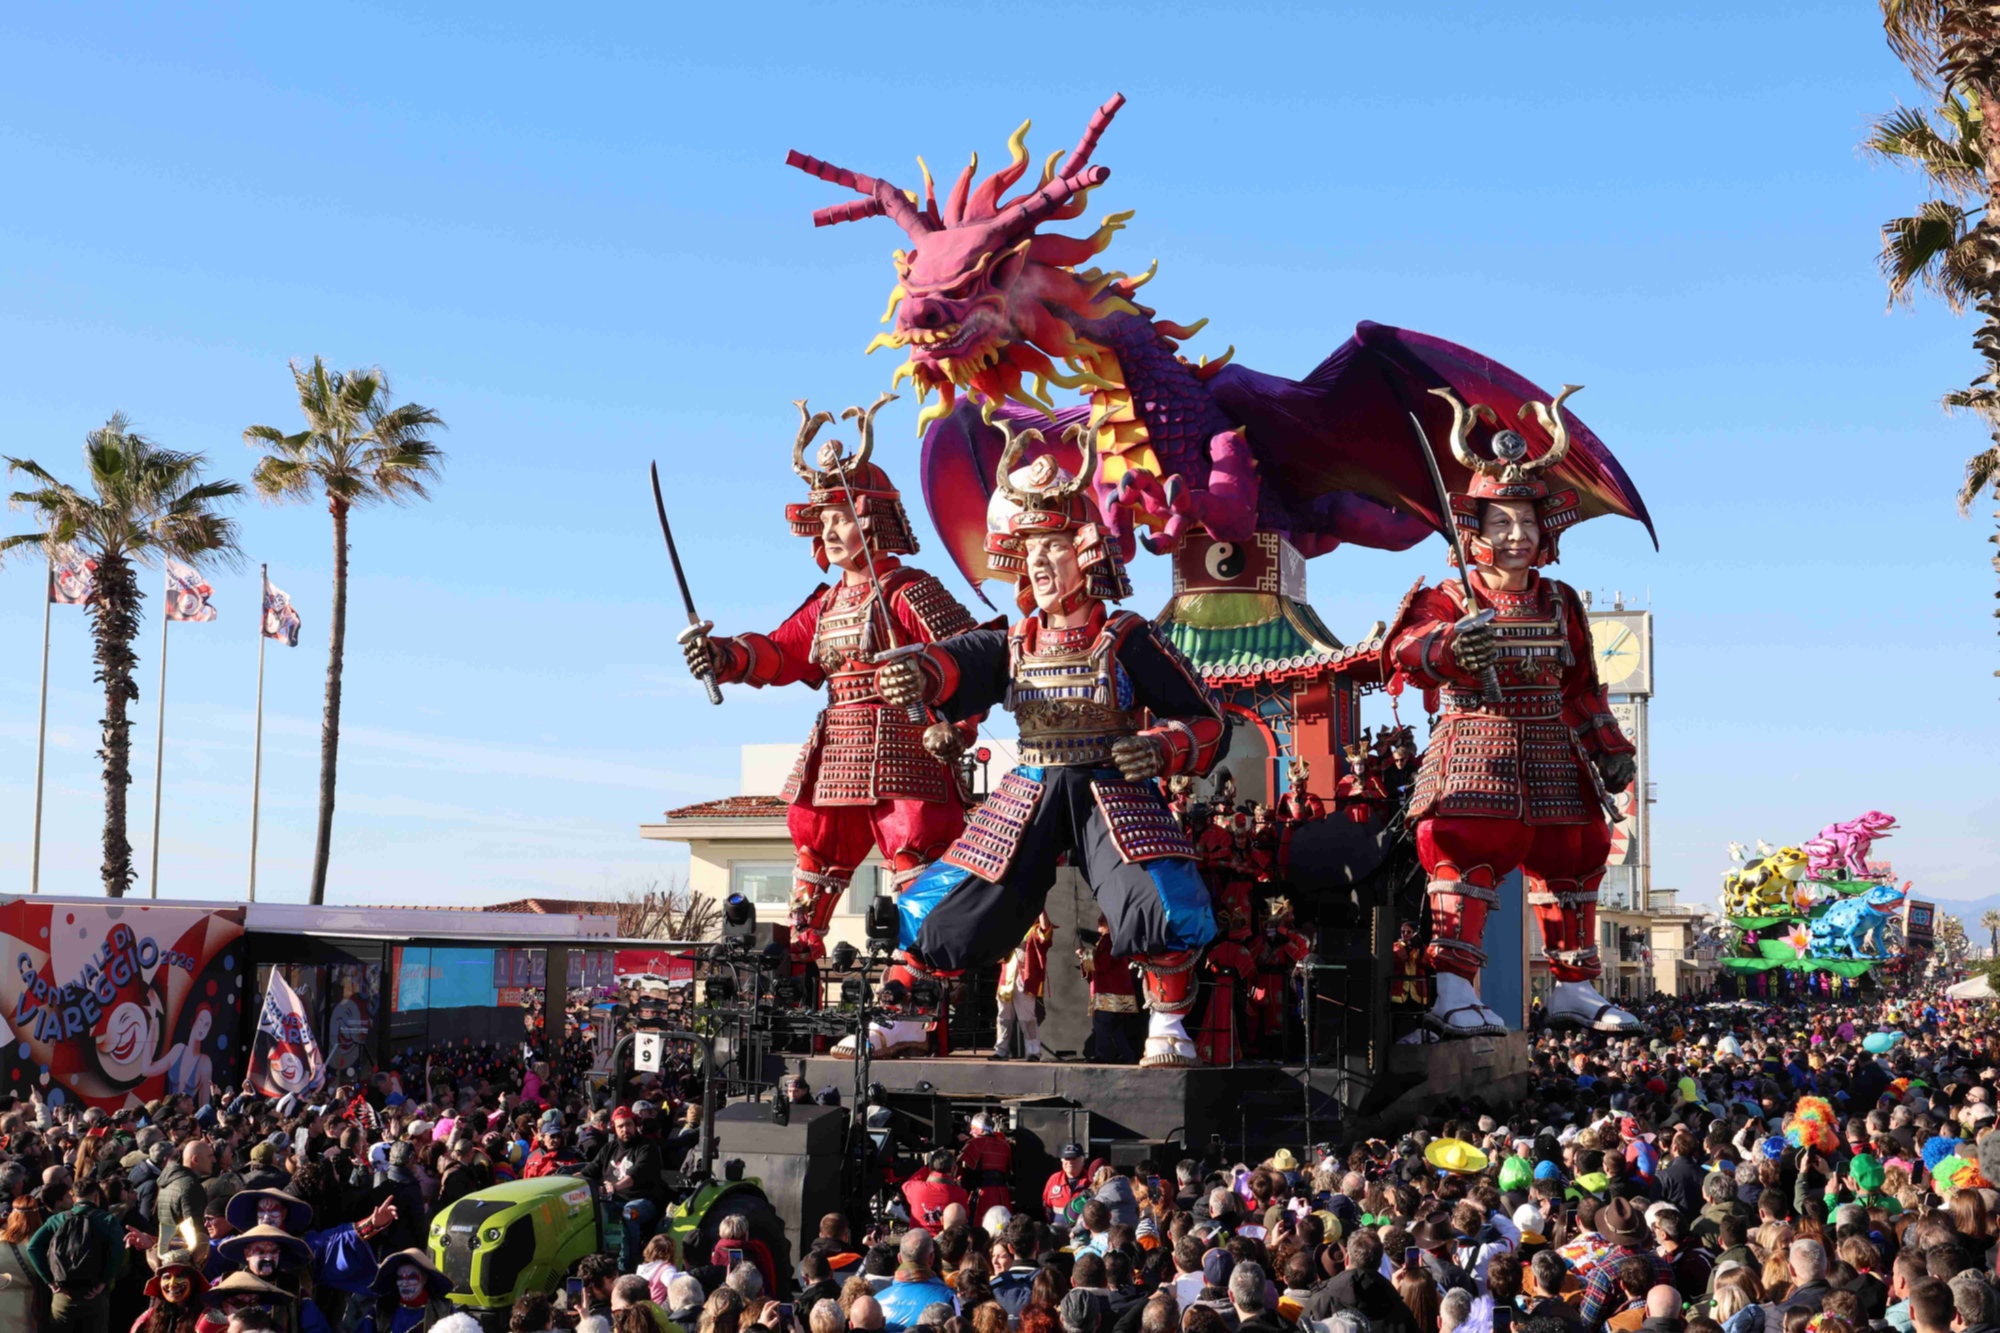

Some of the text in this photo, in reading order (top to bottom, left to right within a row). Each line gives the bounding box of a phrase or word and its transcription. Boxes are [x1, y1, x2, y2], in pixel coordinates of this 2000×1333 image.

[17, 925, 132, 1007] CARNEVALE DI
[160, 950, 196, 972] 2026
[500, 957, 545, 976] 1 7 12
[569, 957, 615, 976] 15 17 21
[16, 936, 159, 1043] VIAREGGIO
[642, 1050, 652, 1063] 9
